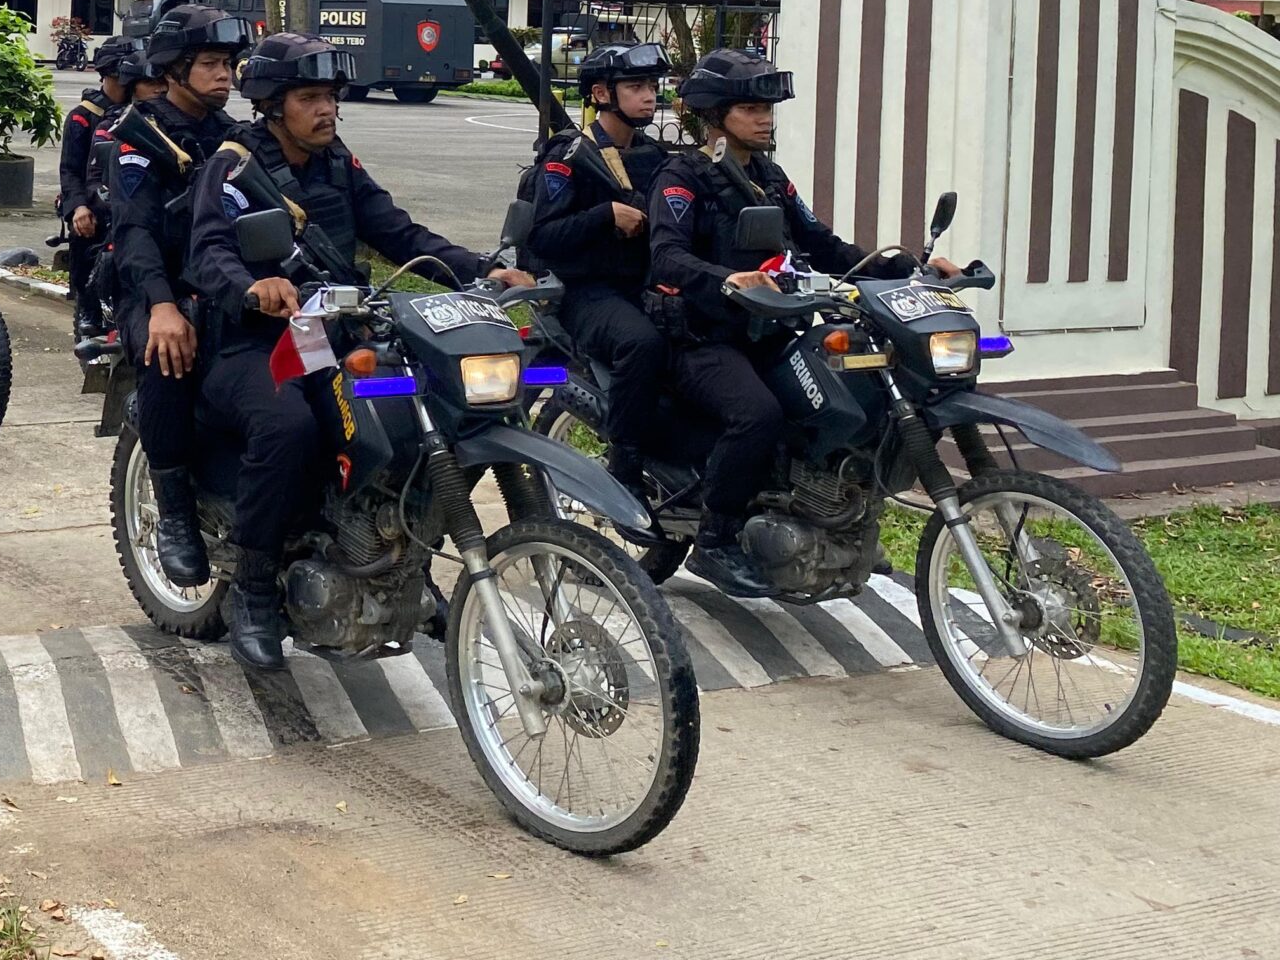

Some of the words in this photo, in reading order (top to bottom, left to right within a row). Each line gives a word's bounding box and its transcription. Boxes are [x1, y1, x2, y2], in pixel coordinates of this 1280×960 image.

[320, 11, 366, 26] POLISI
[346, 37, 365, 46] TEBO
[788, 349, 825, 410] BRIMOB
[332, 371, 356, 442] BRIMOB
